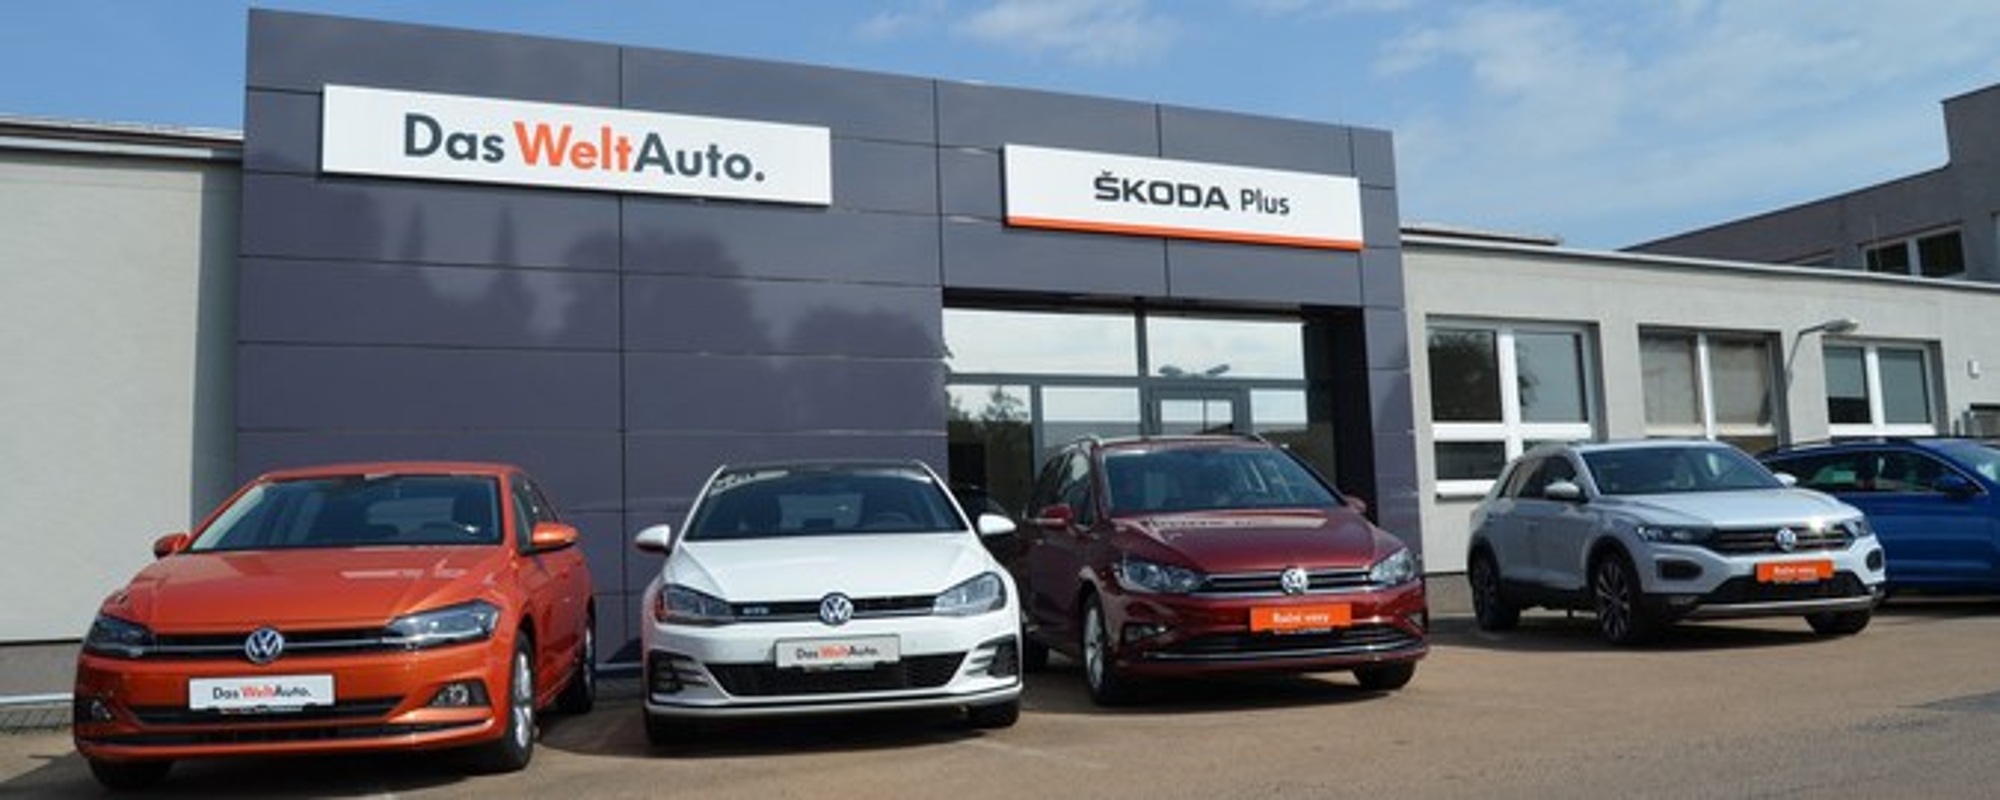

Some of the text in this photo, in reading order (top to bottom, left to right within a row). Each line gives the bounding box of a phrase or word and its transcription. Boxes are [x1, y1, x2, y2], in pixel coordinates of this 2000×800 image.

[404, 113, 766, 182] Das WeltAuto.
[1094, 171, 1290, 215] ŠKODA Plus
[796, 648, 818, 659] Das
[212, 687, 240, 700] Das
